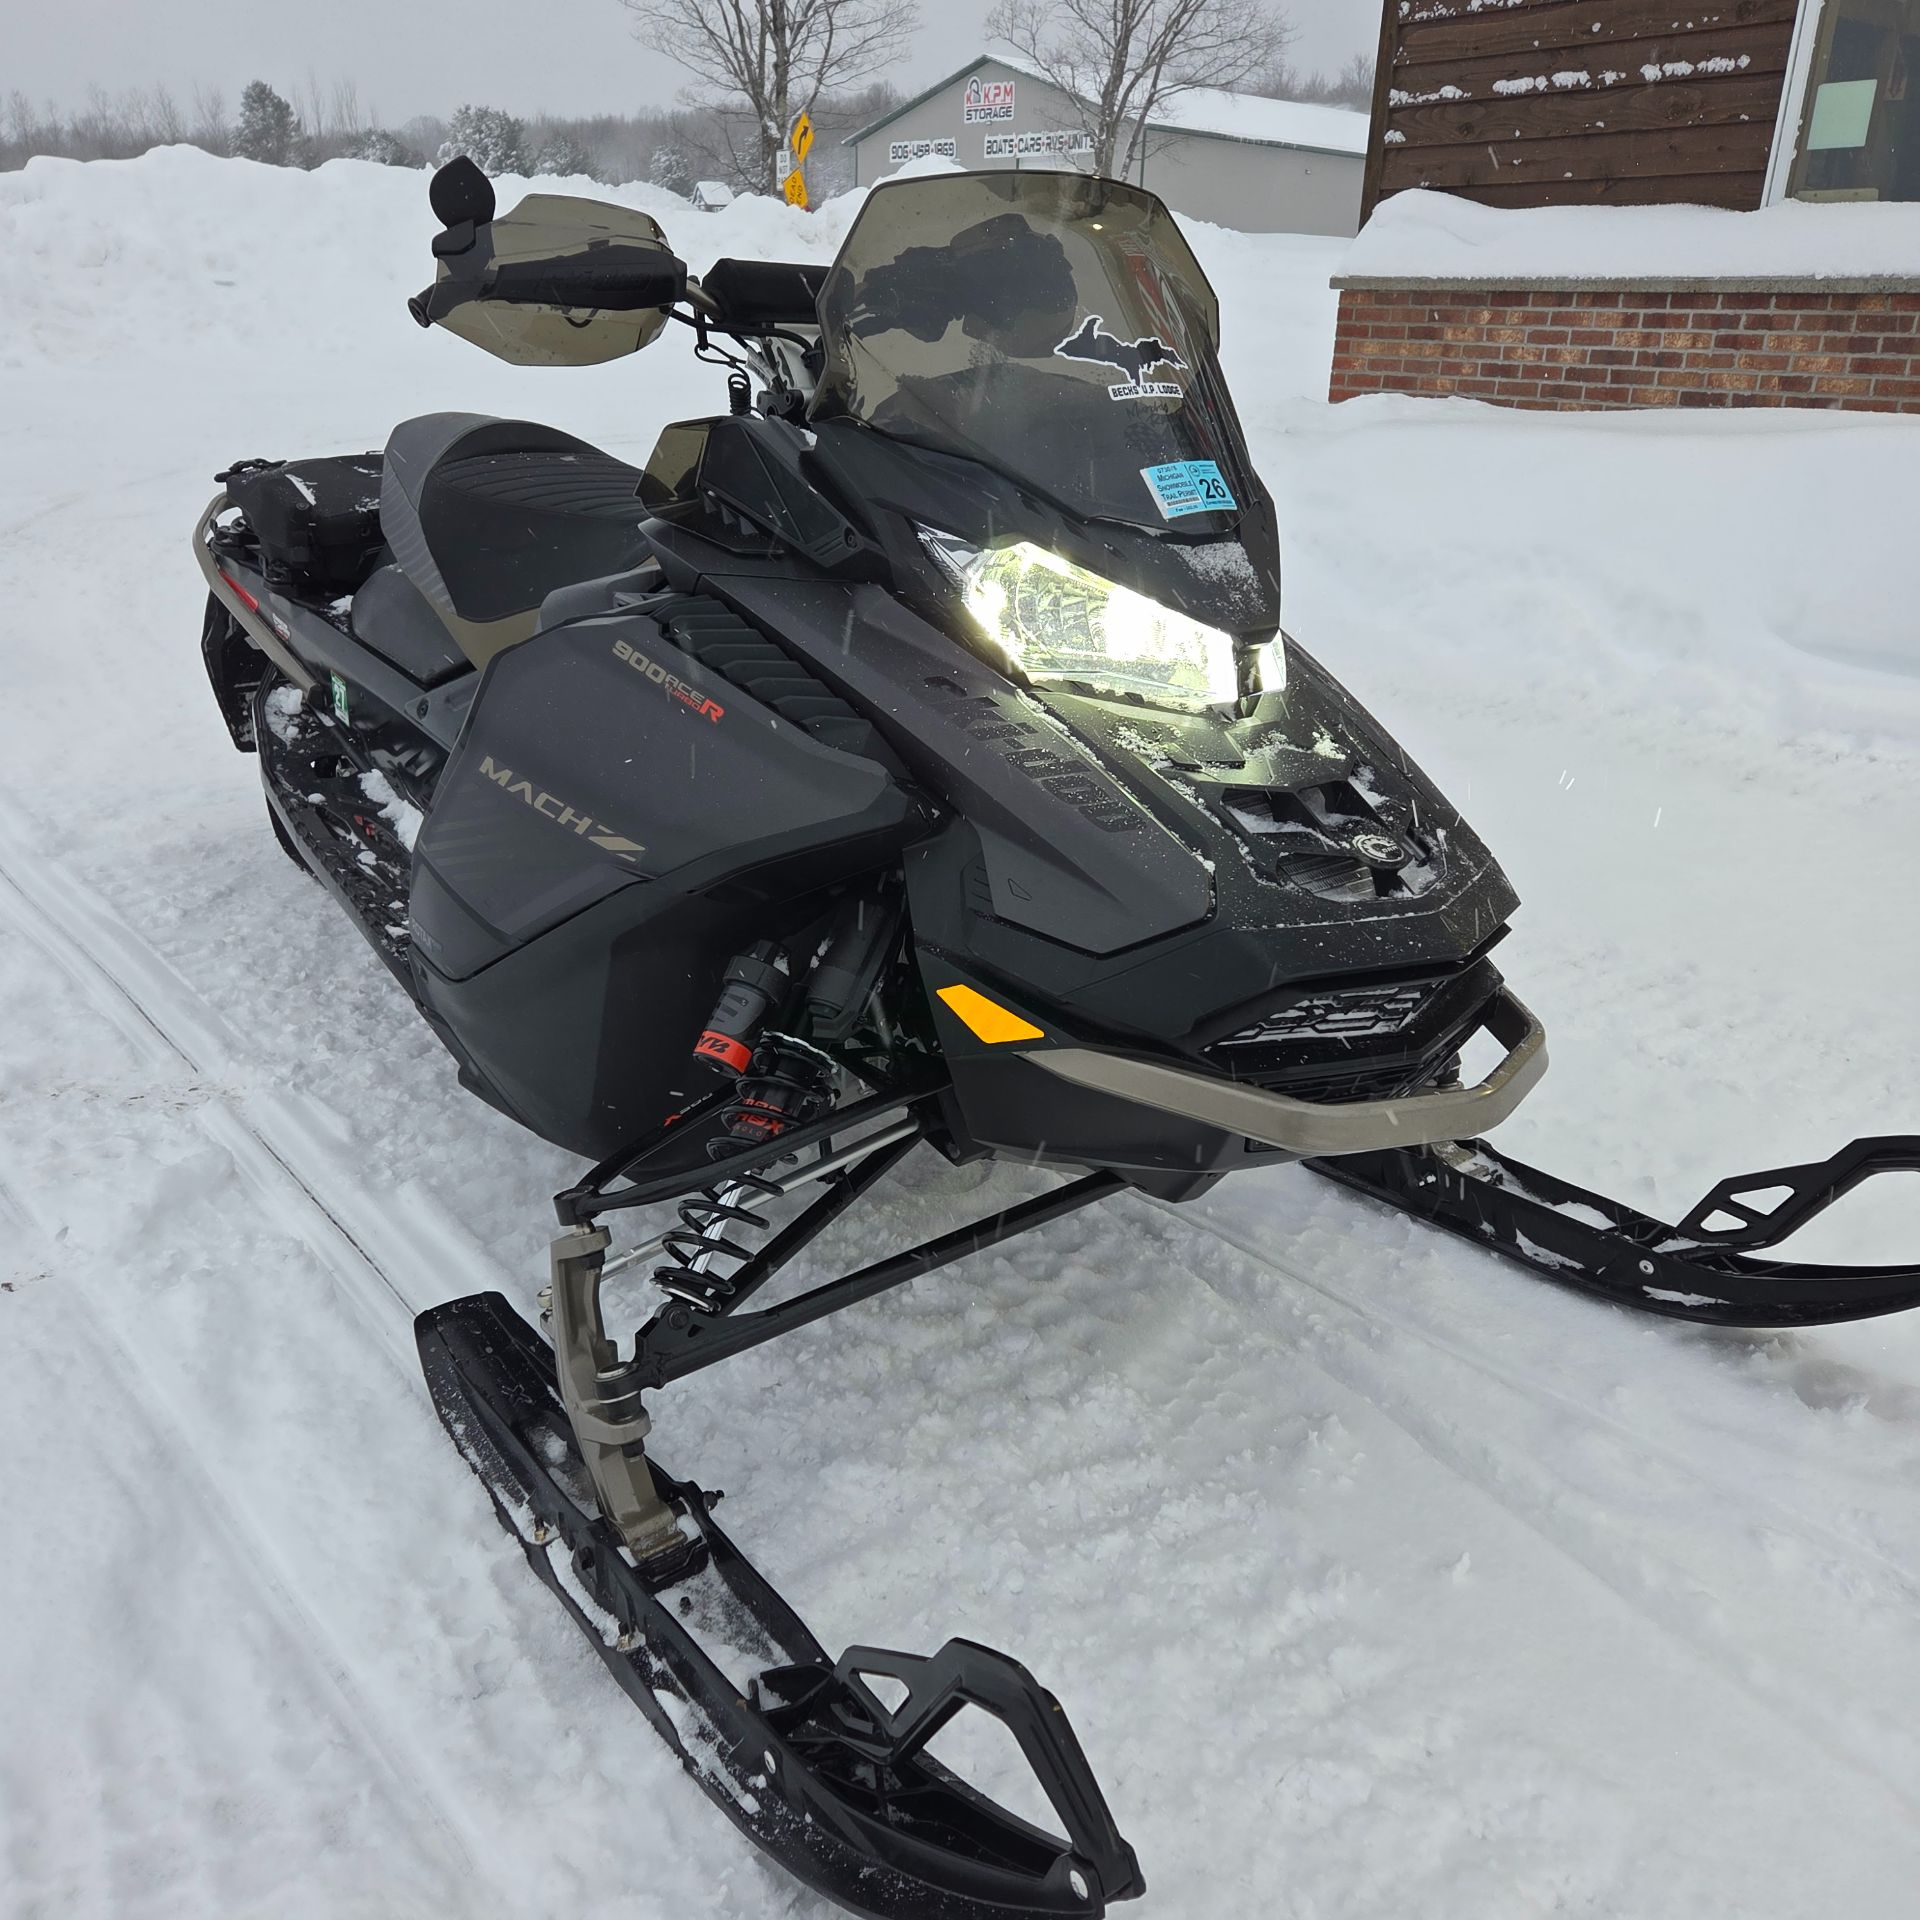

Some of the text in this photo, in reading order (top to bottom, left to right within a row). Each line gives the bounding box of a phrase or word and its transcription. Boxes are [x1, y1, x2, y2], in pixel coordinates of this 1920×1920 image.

[966, 106, 1013, 120] STORAGE
[986, 139, 1014, 155] BOATS
[1018, 137, 1042, 153] CARS
[789, 176, 797, 204] DEAD
[1112, 385, 1139, 398] BECKS
[1158, 384, 1181, 395] LODGE
[1157, 472, 1184, 482] MICHIGAN
[1157, 480, 1194, 492] SNOWMOBILE
[1199, 478, 1226, 498] 26
[1161, 489, 1197, 501] TRAIL PERMIT
[612, 639, 725, 723] 900 ACE R
[479, 755, 592, 835] MACH
